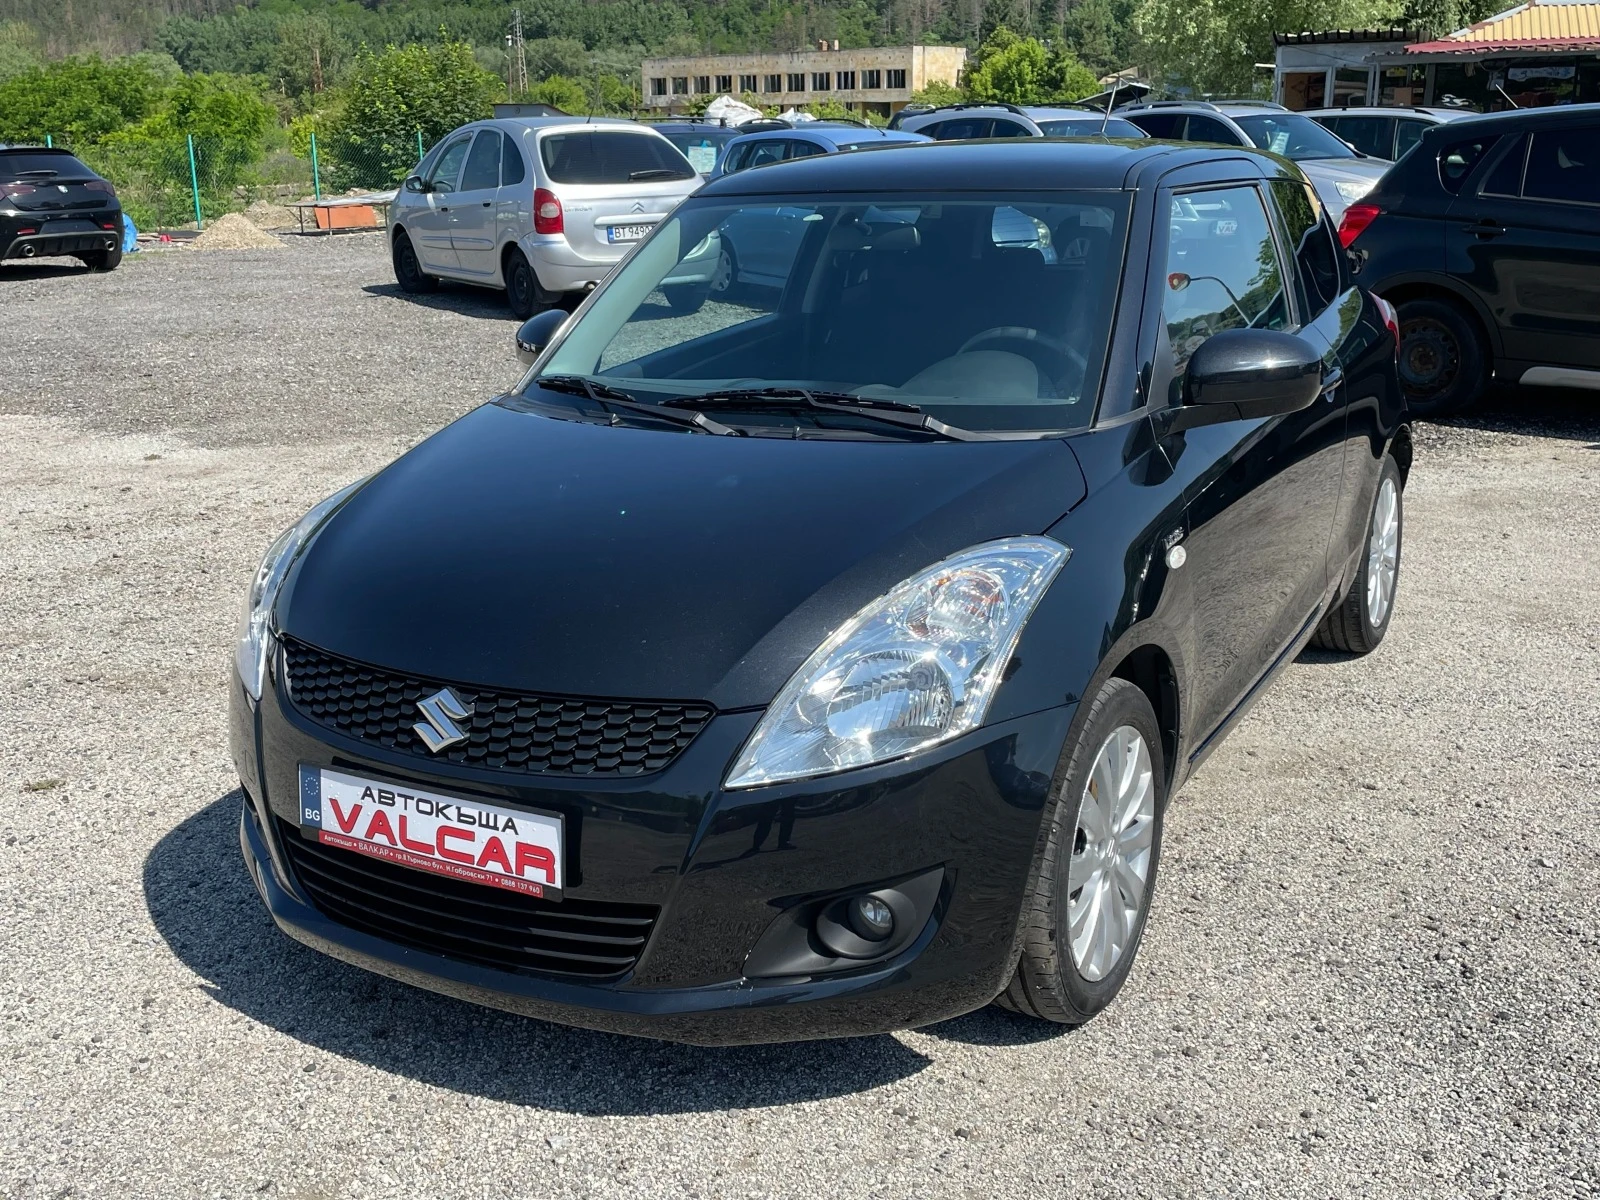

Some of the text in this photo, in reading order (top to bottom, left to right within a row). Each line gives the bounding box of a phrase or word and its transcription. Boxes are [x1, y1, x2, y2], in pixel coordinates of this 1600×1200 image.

[614, 227, 626, 238] BT
[304, 808, 321, 821] BG
[360, 785, 519, 836] АВТОКЪЩА
[328, 797, 556, 885] VALCAR
[358, 842, 389, 856] ВАЛКАР
[486, 874, 493, 882] 71
[501, 878, 516, 888] 0888
[517, 881, 527, 890] 137
